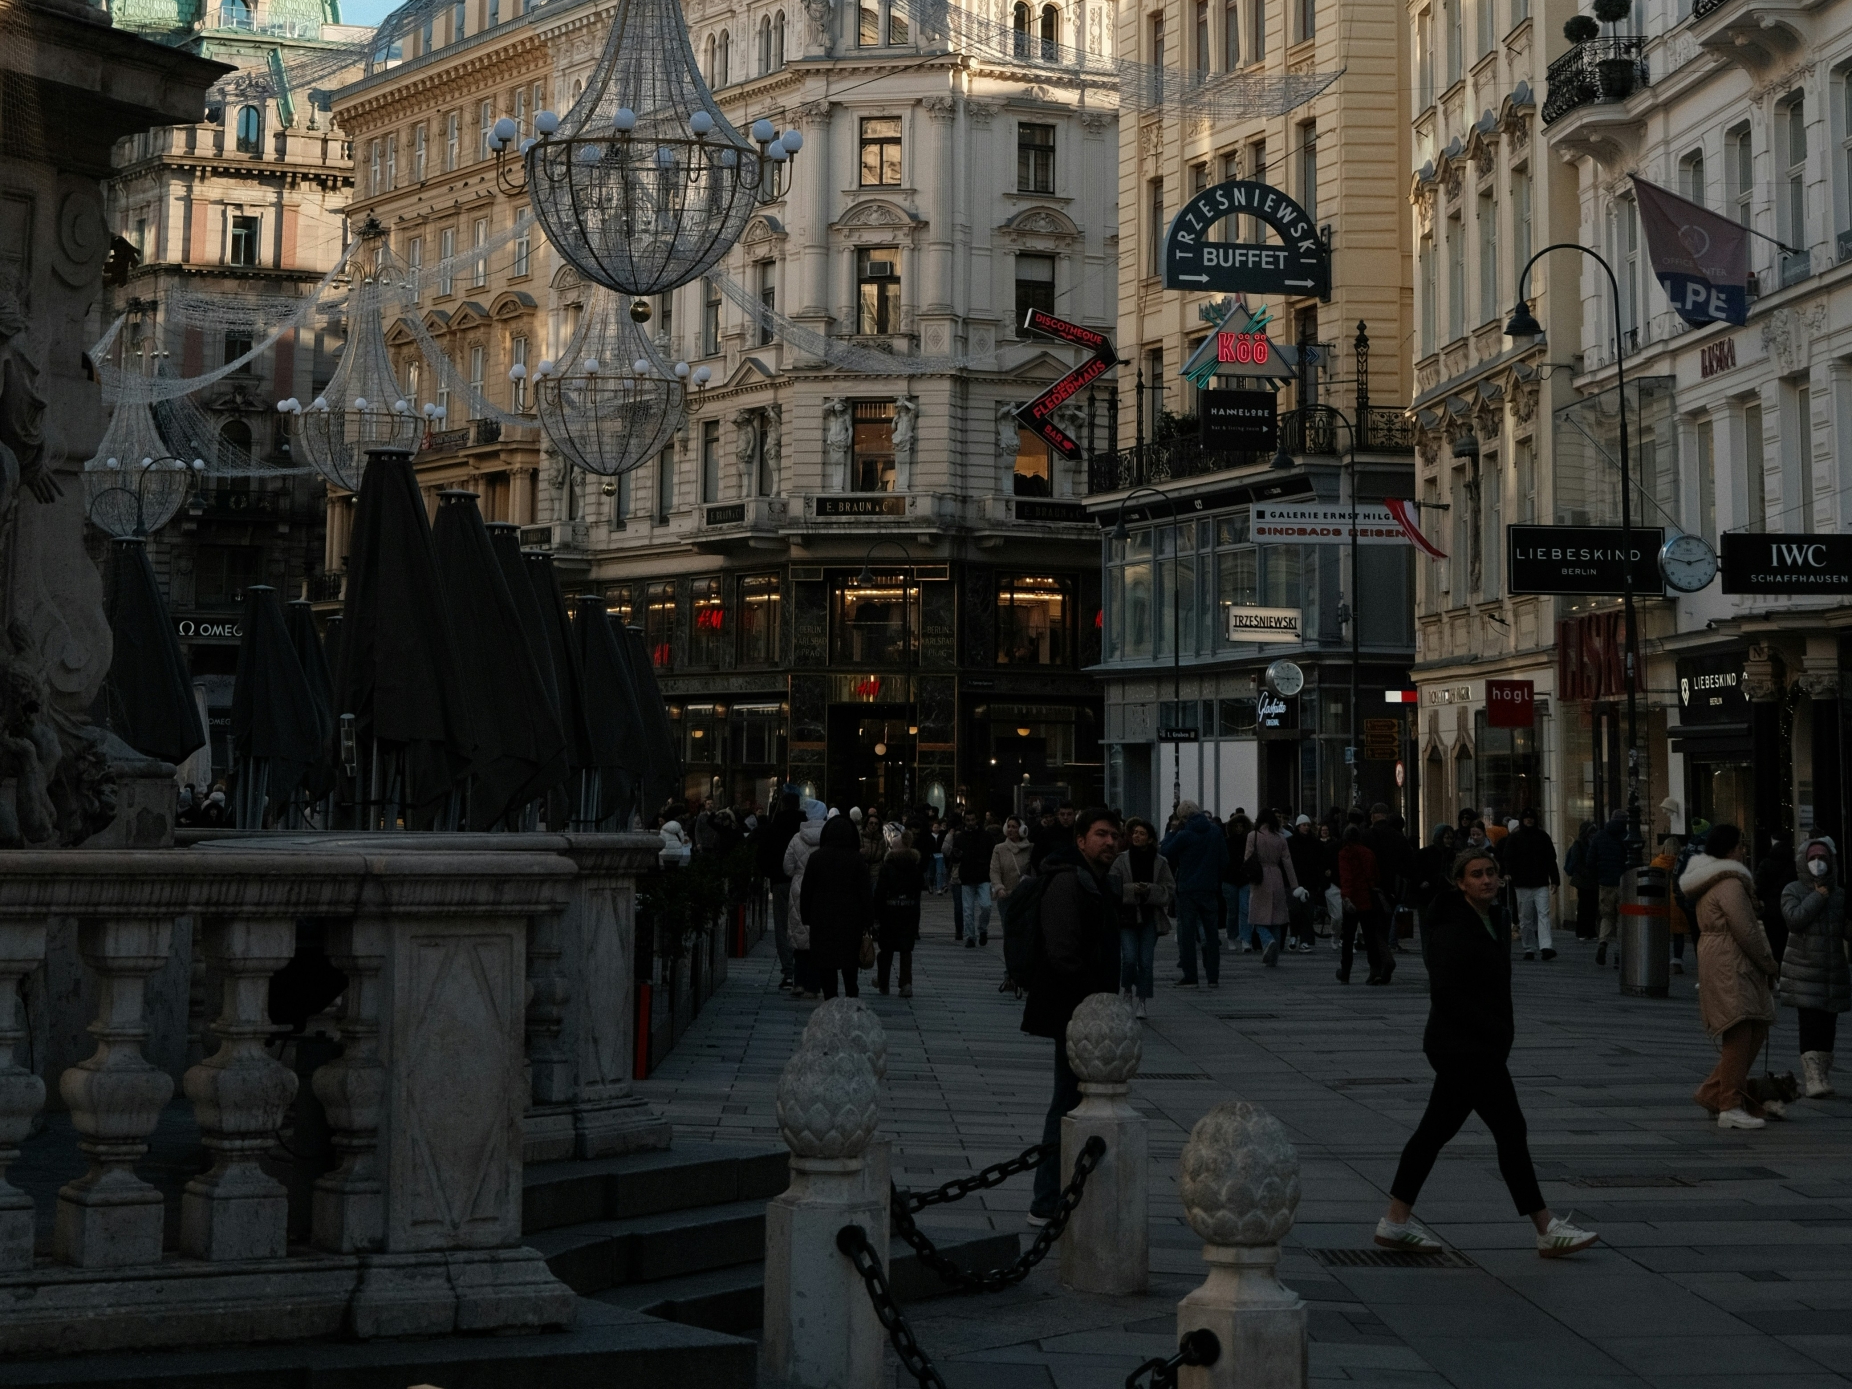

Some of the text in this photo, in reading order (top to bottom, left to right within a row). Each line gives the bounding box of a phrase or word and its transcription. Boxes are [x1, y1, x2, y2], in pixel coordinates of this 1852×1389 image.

[1175, 187, 1317, 264] TRZEŚNIEWSKI
[1203, 248, 1288, 269] BUFFET
[1701, 266, 1727, 276] NTER
[1034, 313, 1104, 345] DISCOTHEQUE
[1032, 360, 1107, 420] FLEDERMAUS
[1052, 372, 1077, 394] CABARET
[1210, 407, 1270, 417] HANNELORE
[1043, 423, 1064, 443] BAR
[838, 501, 872, 512] BRAUN
[1323, 512, 1359, 520] ERNST
[1256, 527, 1407, 538] SINDBADS REISEN
[1516, 547, 1641, 561] LIEBESKIND
[1770, 543, 1827, 567] IWC
[1561, 568, 1597, 576] BERLIN
[1750, 574, 1849, 584] SCHAFFHAUSEN
[1233, 615, 1297, 629] TRZEŚNIEWSKI
[199, 623, 243, 637] OMEG
[1693, 672, 1737, 690] LIEBESKIND
[207, 718, 231, 726] OMEG
